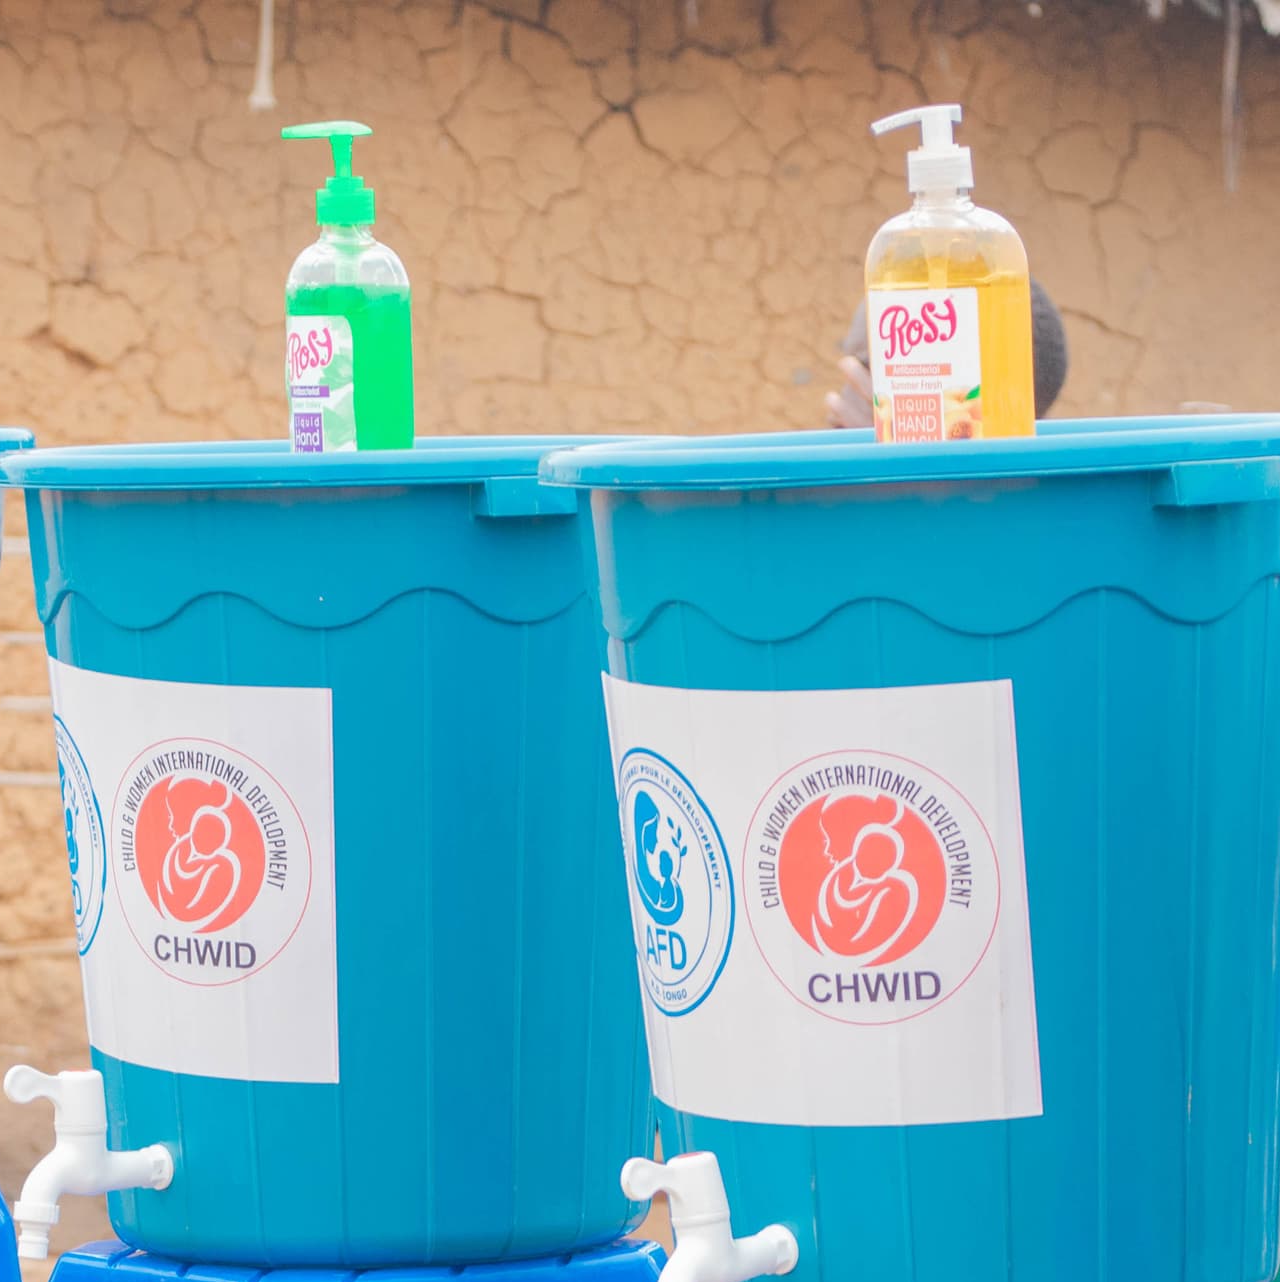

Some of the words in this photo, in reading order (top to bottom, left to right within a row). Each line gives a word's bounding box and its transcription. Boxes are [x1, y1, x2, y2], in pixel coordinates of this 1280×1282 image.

[896, 398, 936, 413] LIQUID
[897, 415, 937, 433] HAND
[124, 765, 156, 812] WOMEN
[152, 750, 248, 793] INTERNATIONAL
[801, 764, 922, 805] INTERNATIONAL
[763, 785, 805, 841] WOMEN
[121, 828, 136, 872] CHILD
[245, 785, 288, 891] DEVELOPMENT
[919, 795, 972, 909] DEVELOPMENT
[758, 861, 780, 909] CHILD
[154, 933, 257, 969] CHWID
[646, 924, 687, 970] AFD
[808, 971, 942, 1003] CHWID
